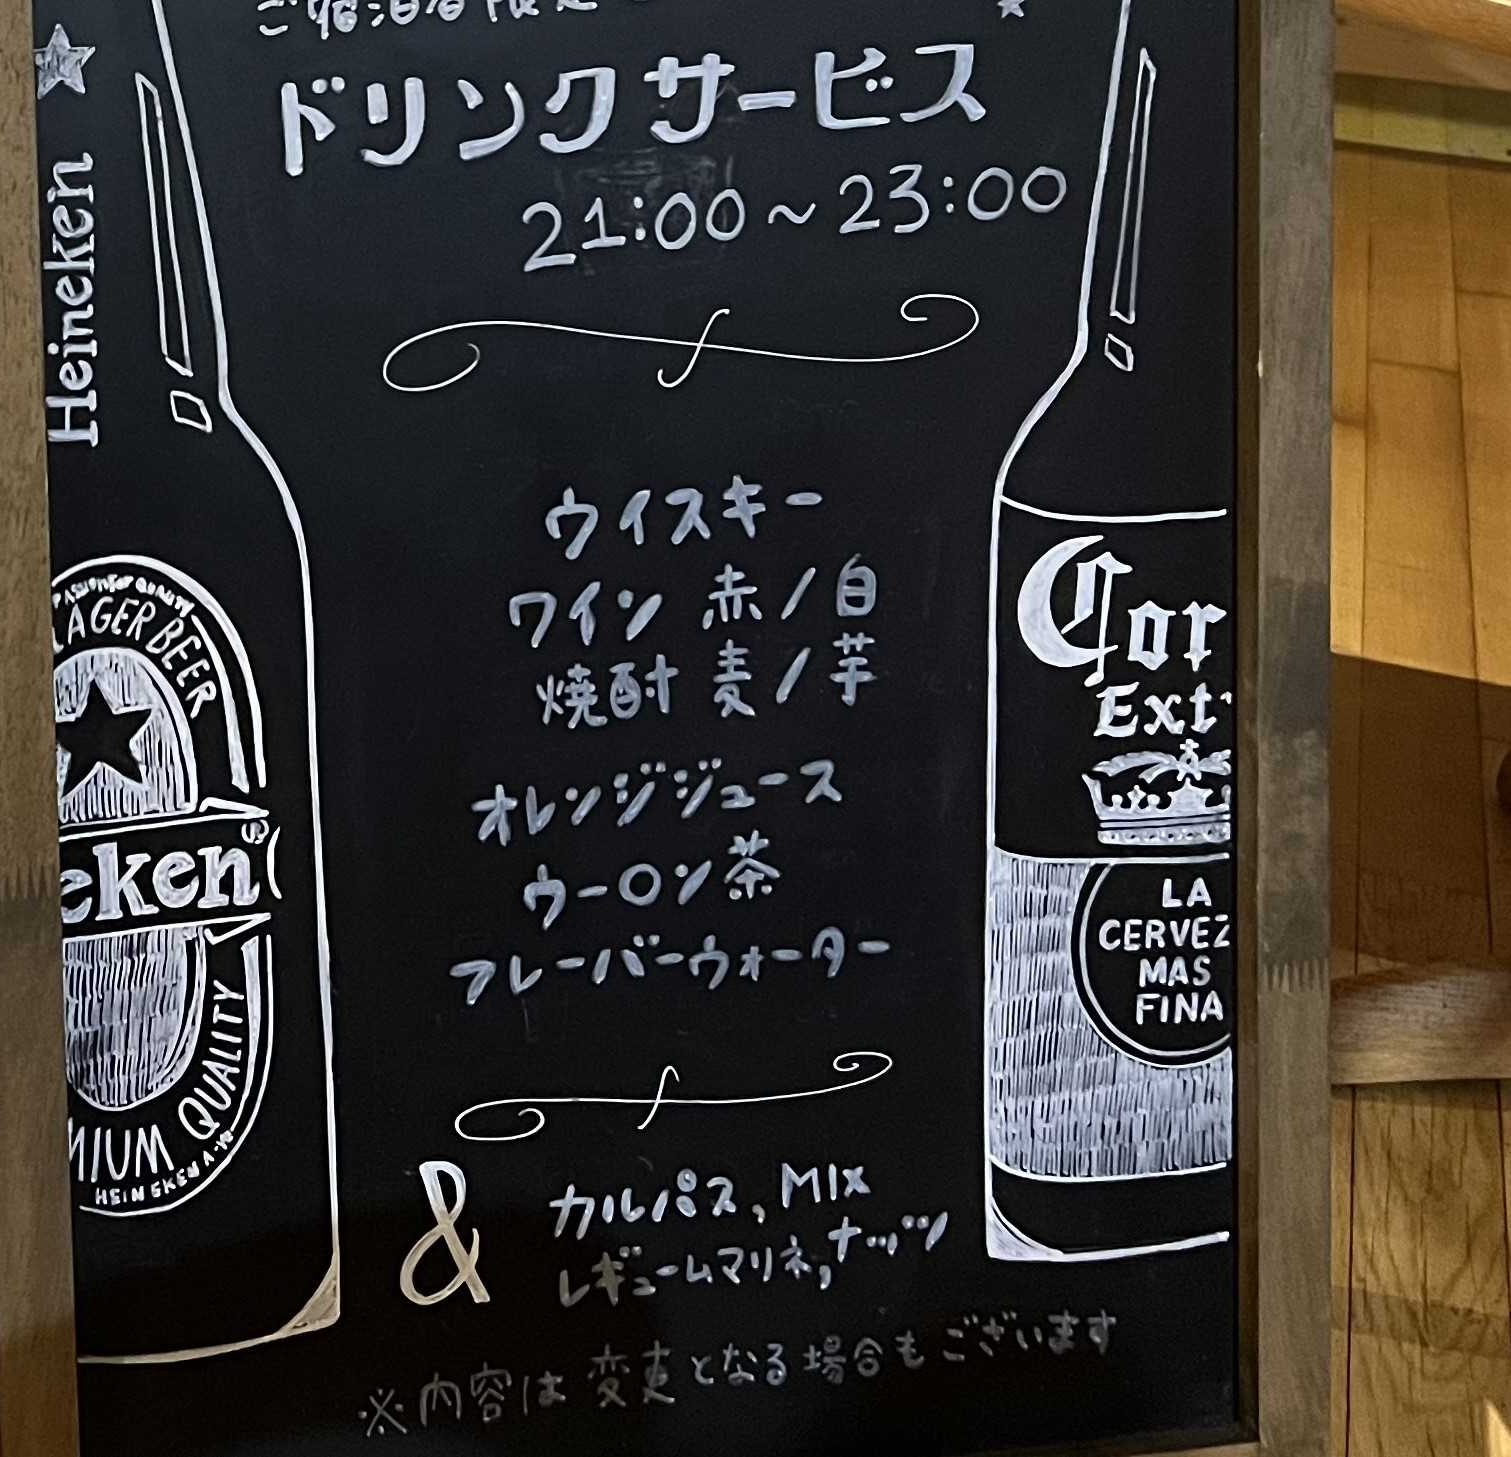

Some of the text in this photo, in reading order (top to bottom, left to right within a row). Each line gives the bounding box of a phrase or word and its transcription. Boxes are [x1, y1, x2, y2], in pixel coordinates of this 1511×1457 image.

[281, 42, 986, 175] ドリンクサービス
[43, 152, 98, 448] Heineken
[544, 474, 823, 559] ウイスキー
[509, 581, 663, 648] ワイン
[1017, 535, 1227, 687] Cor
[145, 617, 217, 719] BEER
[536, 653, 679, 729] 焼酎
[1093, 681, 1232, 737] Ext
[471, 757, 842, 846] オレンジジュース
[1162, 877, 1212, 909] LA
[450, 927, 890, 1005] フレーバーウォーター
[1135, 992, 1224, 1025] FINA
[1138, 955, 1211, 989] MAS
[178, 980, 244, 1140] QUALITY
[399, 1160, 489, 1304] &
